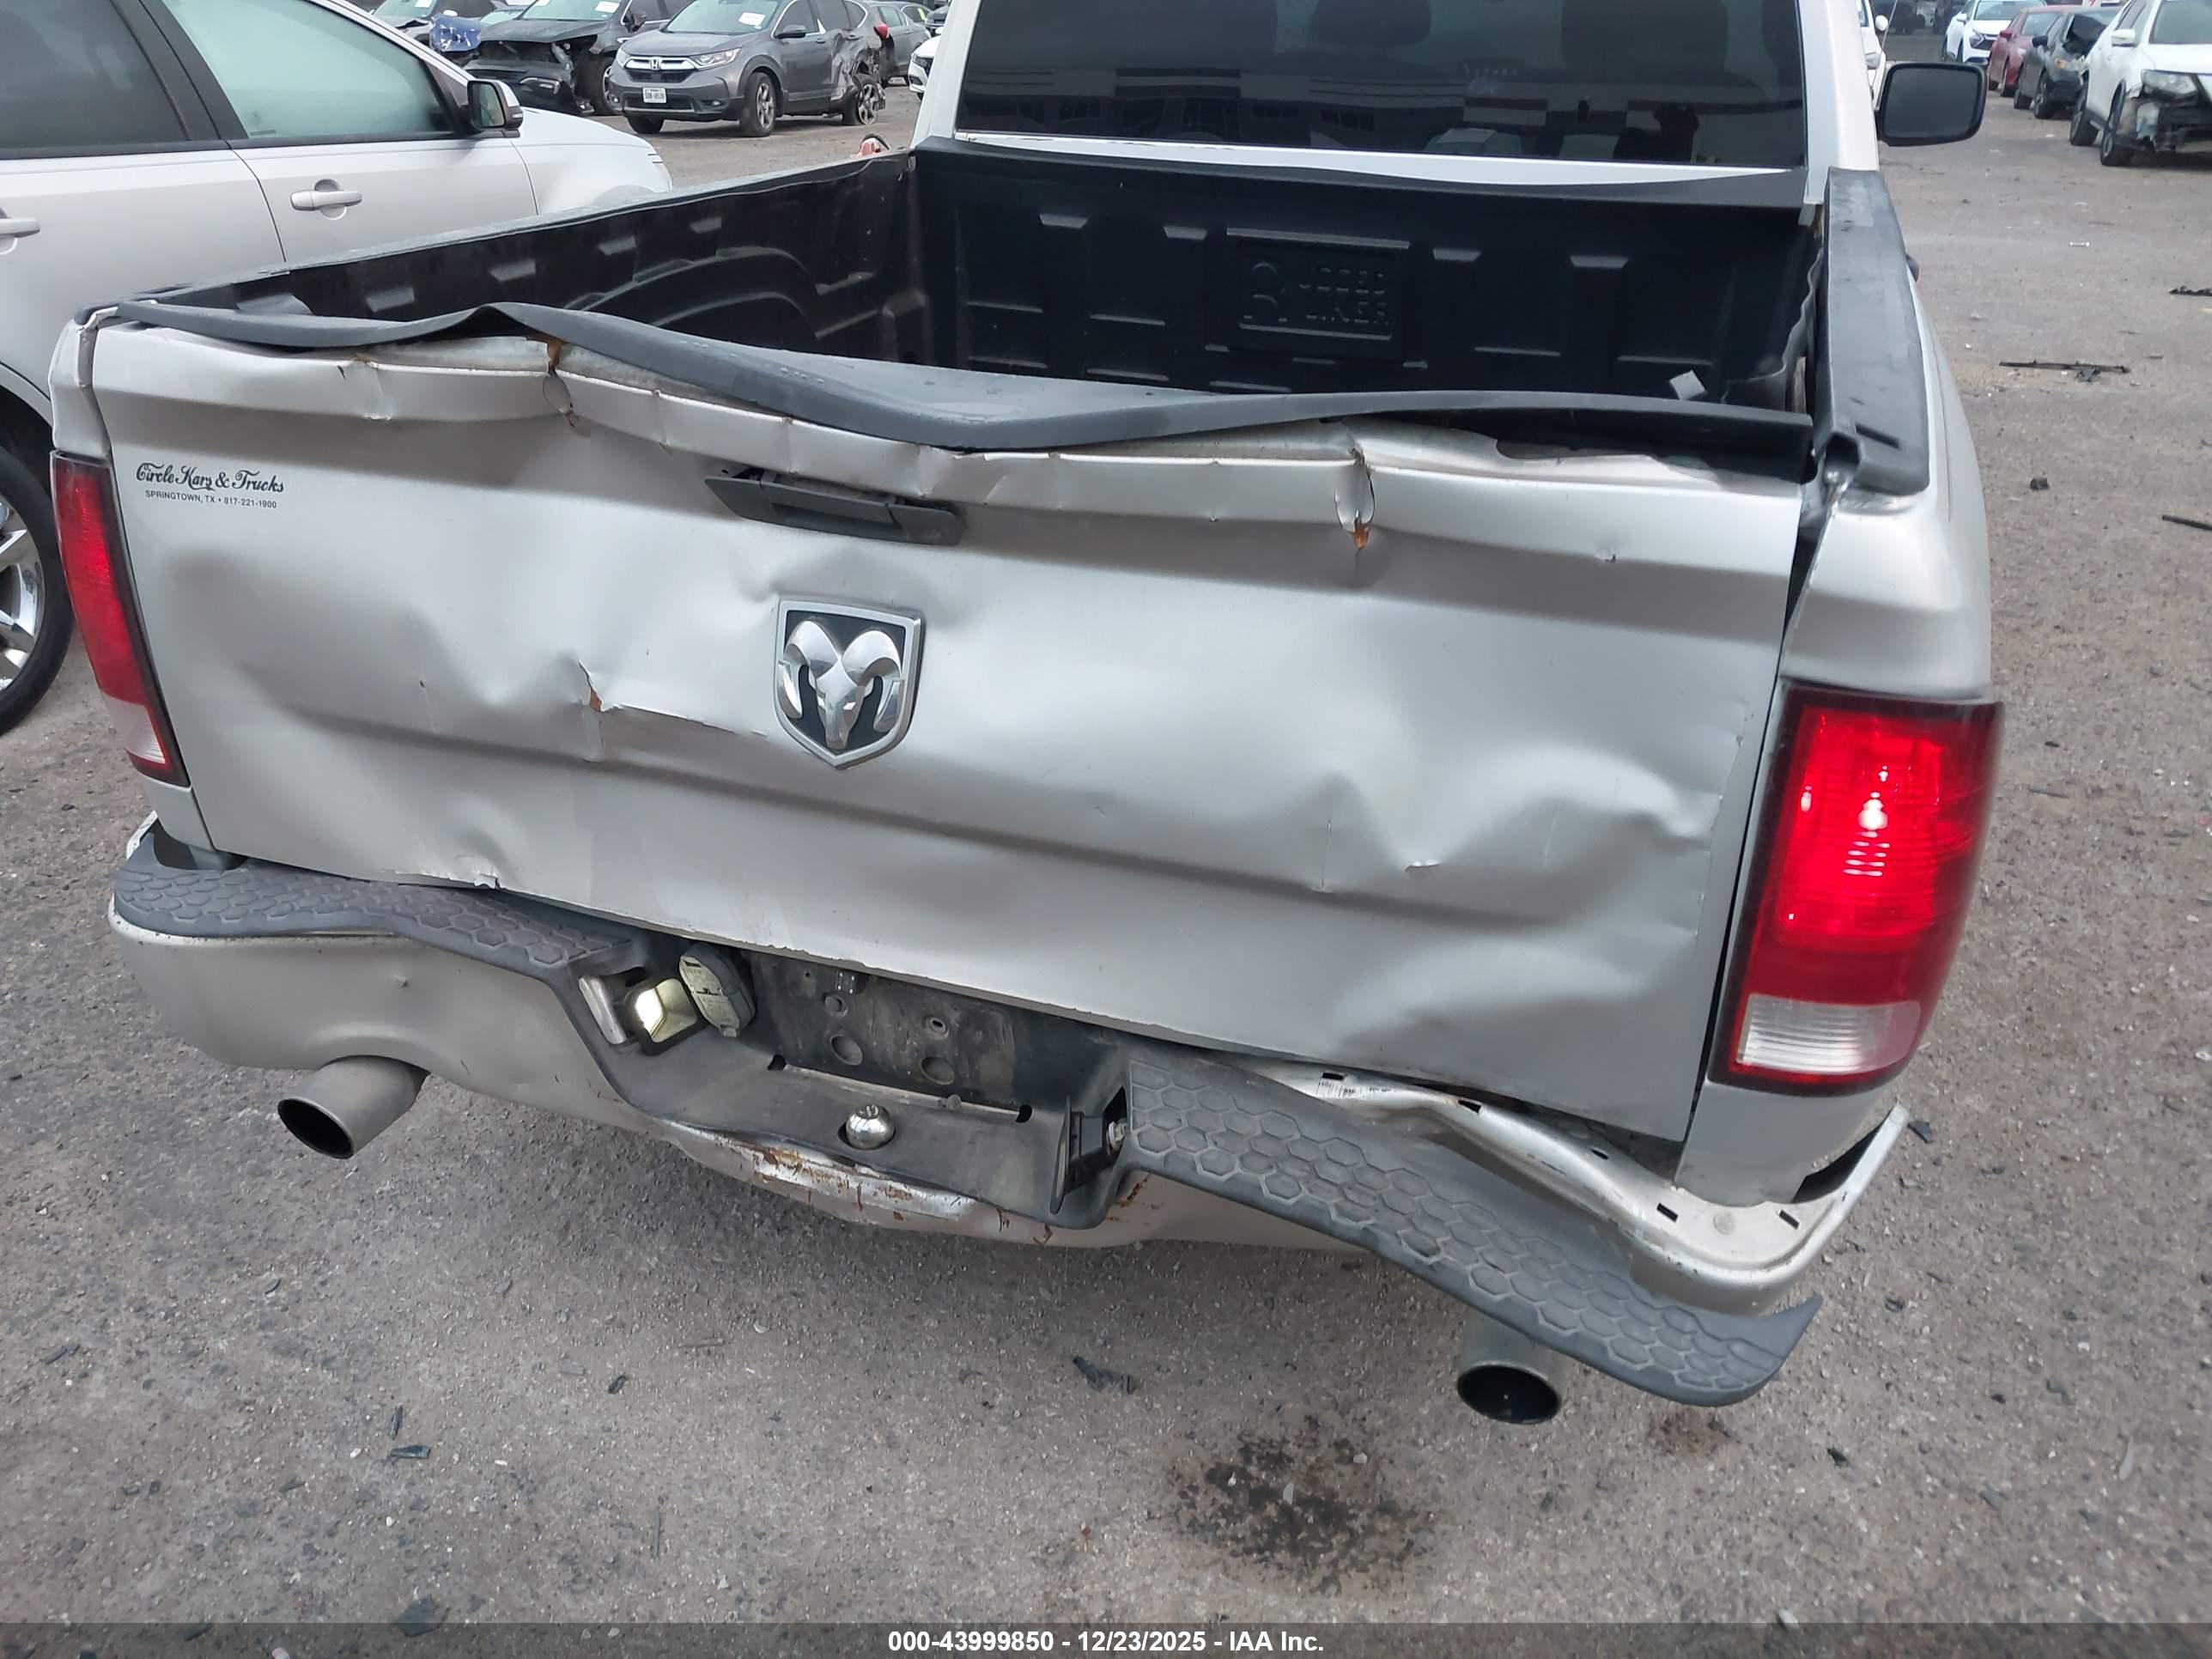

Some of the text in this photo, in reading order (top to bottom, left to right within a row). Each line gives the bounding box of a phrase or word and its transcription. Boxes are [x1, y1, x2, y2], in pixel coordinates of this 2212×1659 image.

[136, 462, 175, 484] Circle
[215, 471, 230, 489] &
[231, 470, 284, 493] Trucks
[145, 489, 277, 508] SPRINGTOWN, TX 817-221-1900
